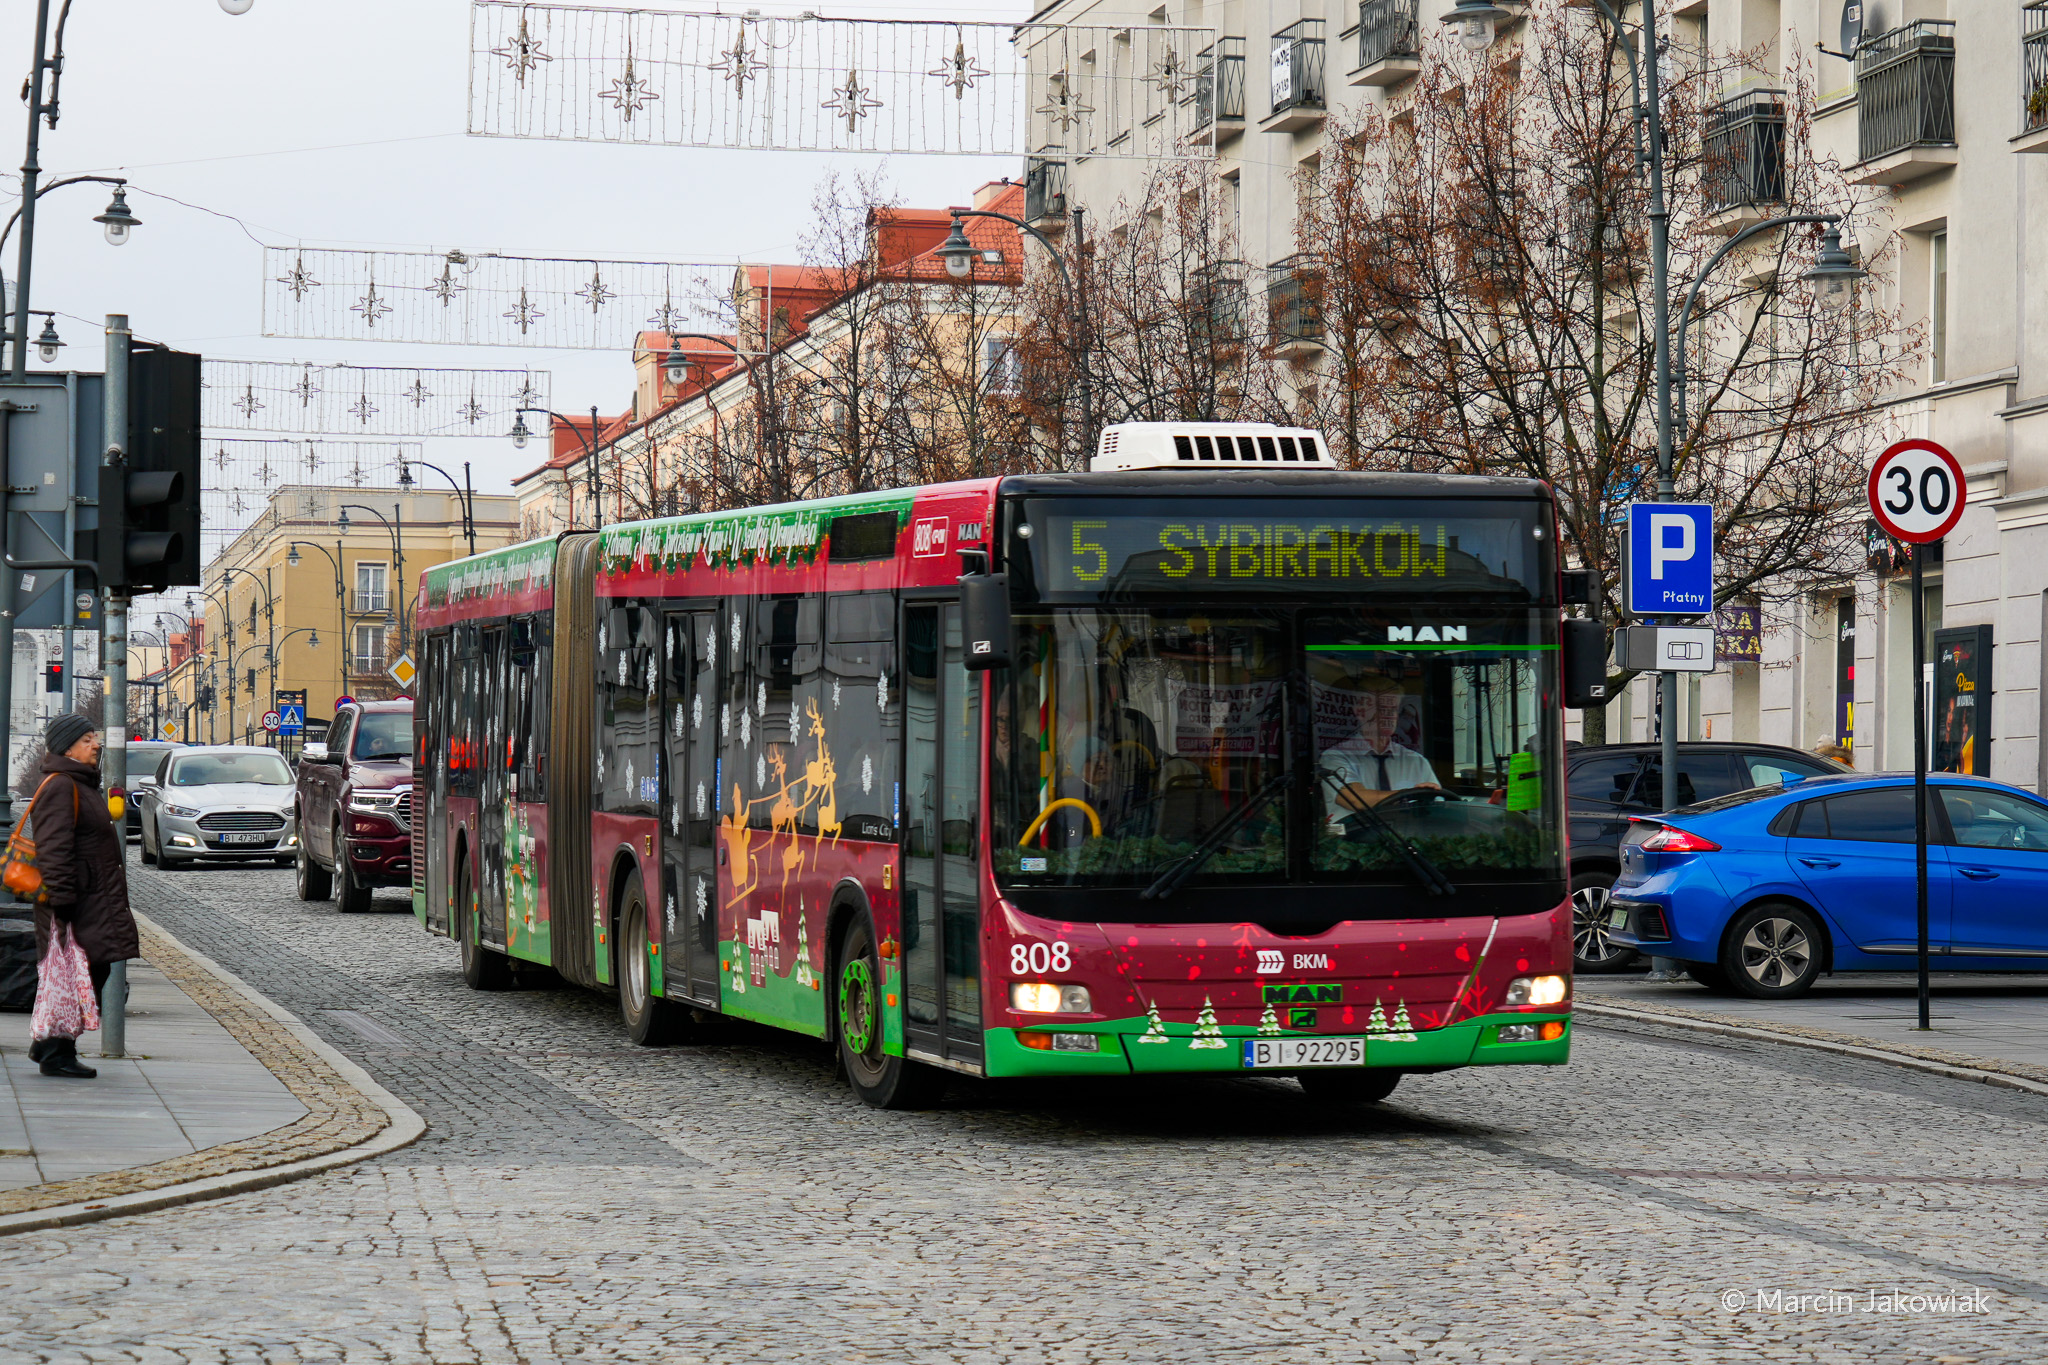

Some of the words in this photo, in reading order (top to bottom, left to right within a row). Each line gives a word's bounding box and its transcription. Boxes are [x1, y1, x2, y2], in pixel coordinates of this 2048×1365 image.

[1884, 465, 1951, 516] 30
[957, 522, 983, 541] MAN
[1071, 520, 1108, 582] 5
[1650, 513, 1696, 580] P
[1662, 590, 1705, 607] Płatny
[1387, 625, 1467, 641] MAN
[1956, 671, 1975, 693] Pizza
[265, 715, 279, 726] 30
[224, 834, 234, 843] BI
[238, 833, 263, 842] 473HU
[879, 823, 893, 841] City
[1010, 941, 1072, 975] 808
[1293, 953, 1329, 969] BKM
[1264, 985, 1343, 1003] MAN
[1257, 1043, 1282, 1064] BI
[1296, 1041, 1361, 1063] 92295
